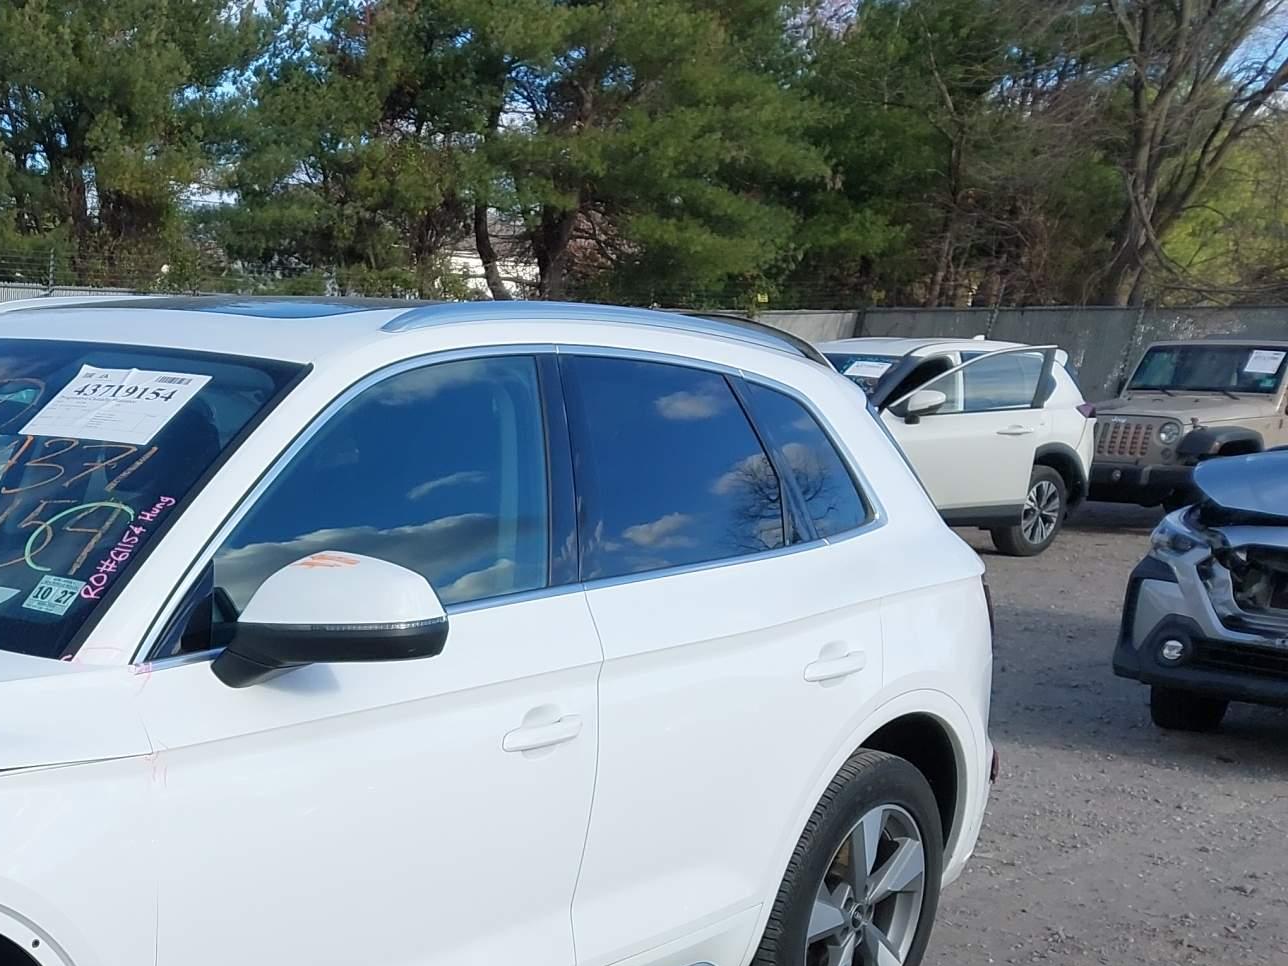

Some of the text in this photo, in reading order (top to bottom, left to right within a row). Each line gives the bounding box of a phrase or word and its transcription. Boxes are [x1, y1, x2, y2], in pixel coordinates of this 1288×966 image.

[73, 383, 179, 402] 43719154
[32, 585, 77, 605] 10 27
